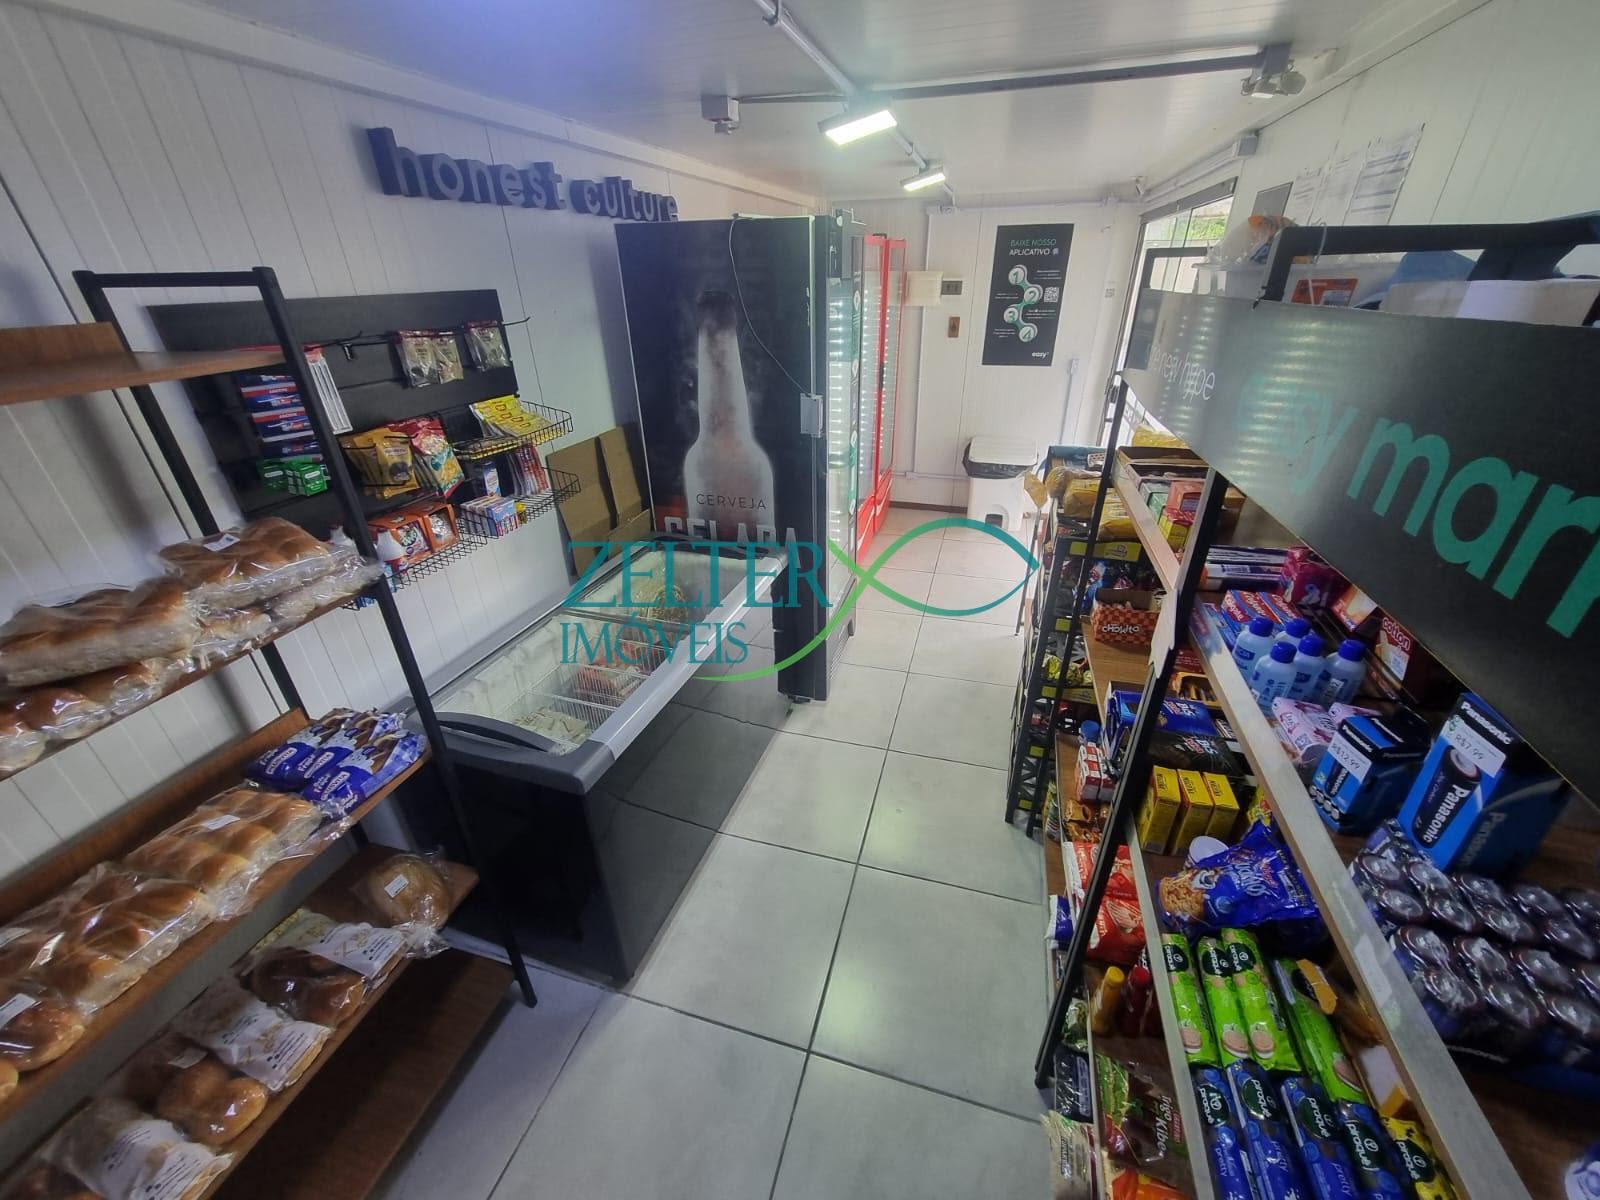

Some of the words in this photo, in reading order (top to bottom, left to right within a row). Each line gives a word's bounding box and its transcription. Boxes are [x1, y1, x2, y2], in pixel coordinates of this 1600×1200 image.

[366, 127, 568, 210] honest
[570, 176, 679, 222] culture
[1009, 247, 1050, 256] APLICATIVO
[1010, 239, 1030, 247] BAIXE
[1031, 238, 1057, 247] NOSSO
[696, 493, 767, 510] CERVEJA
[1382, 617, 1411, 651] cotton
[1461, 701, 1514, 745] Panasonic
[1423, 783, 1471, 844] Panasonic
